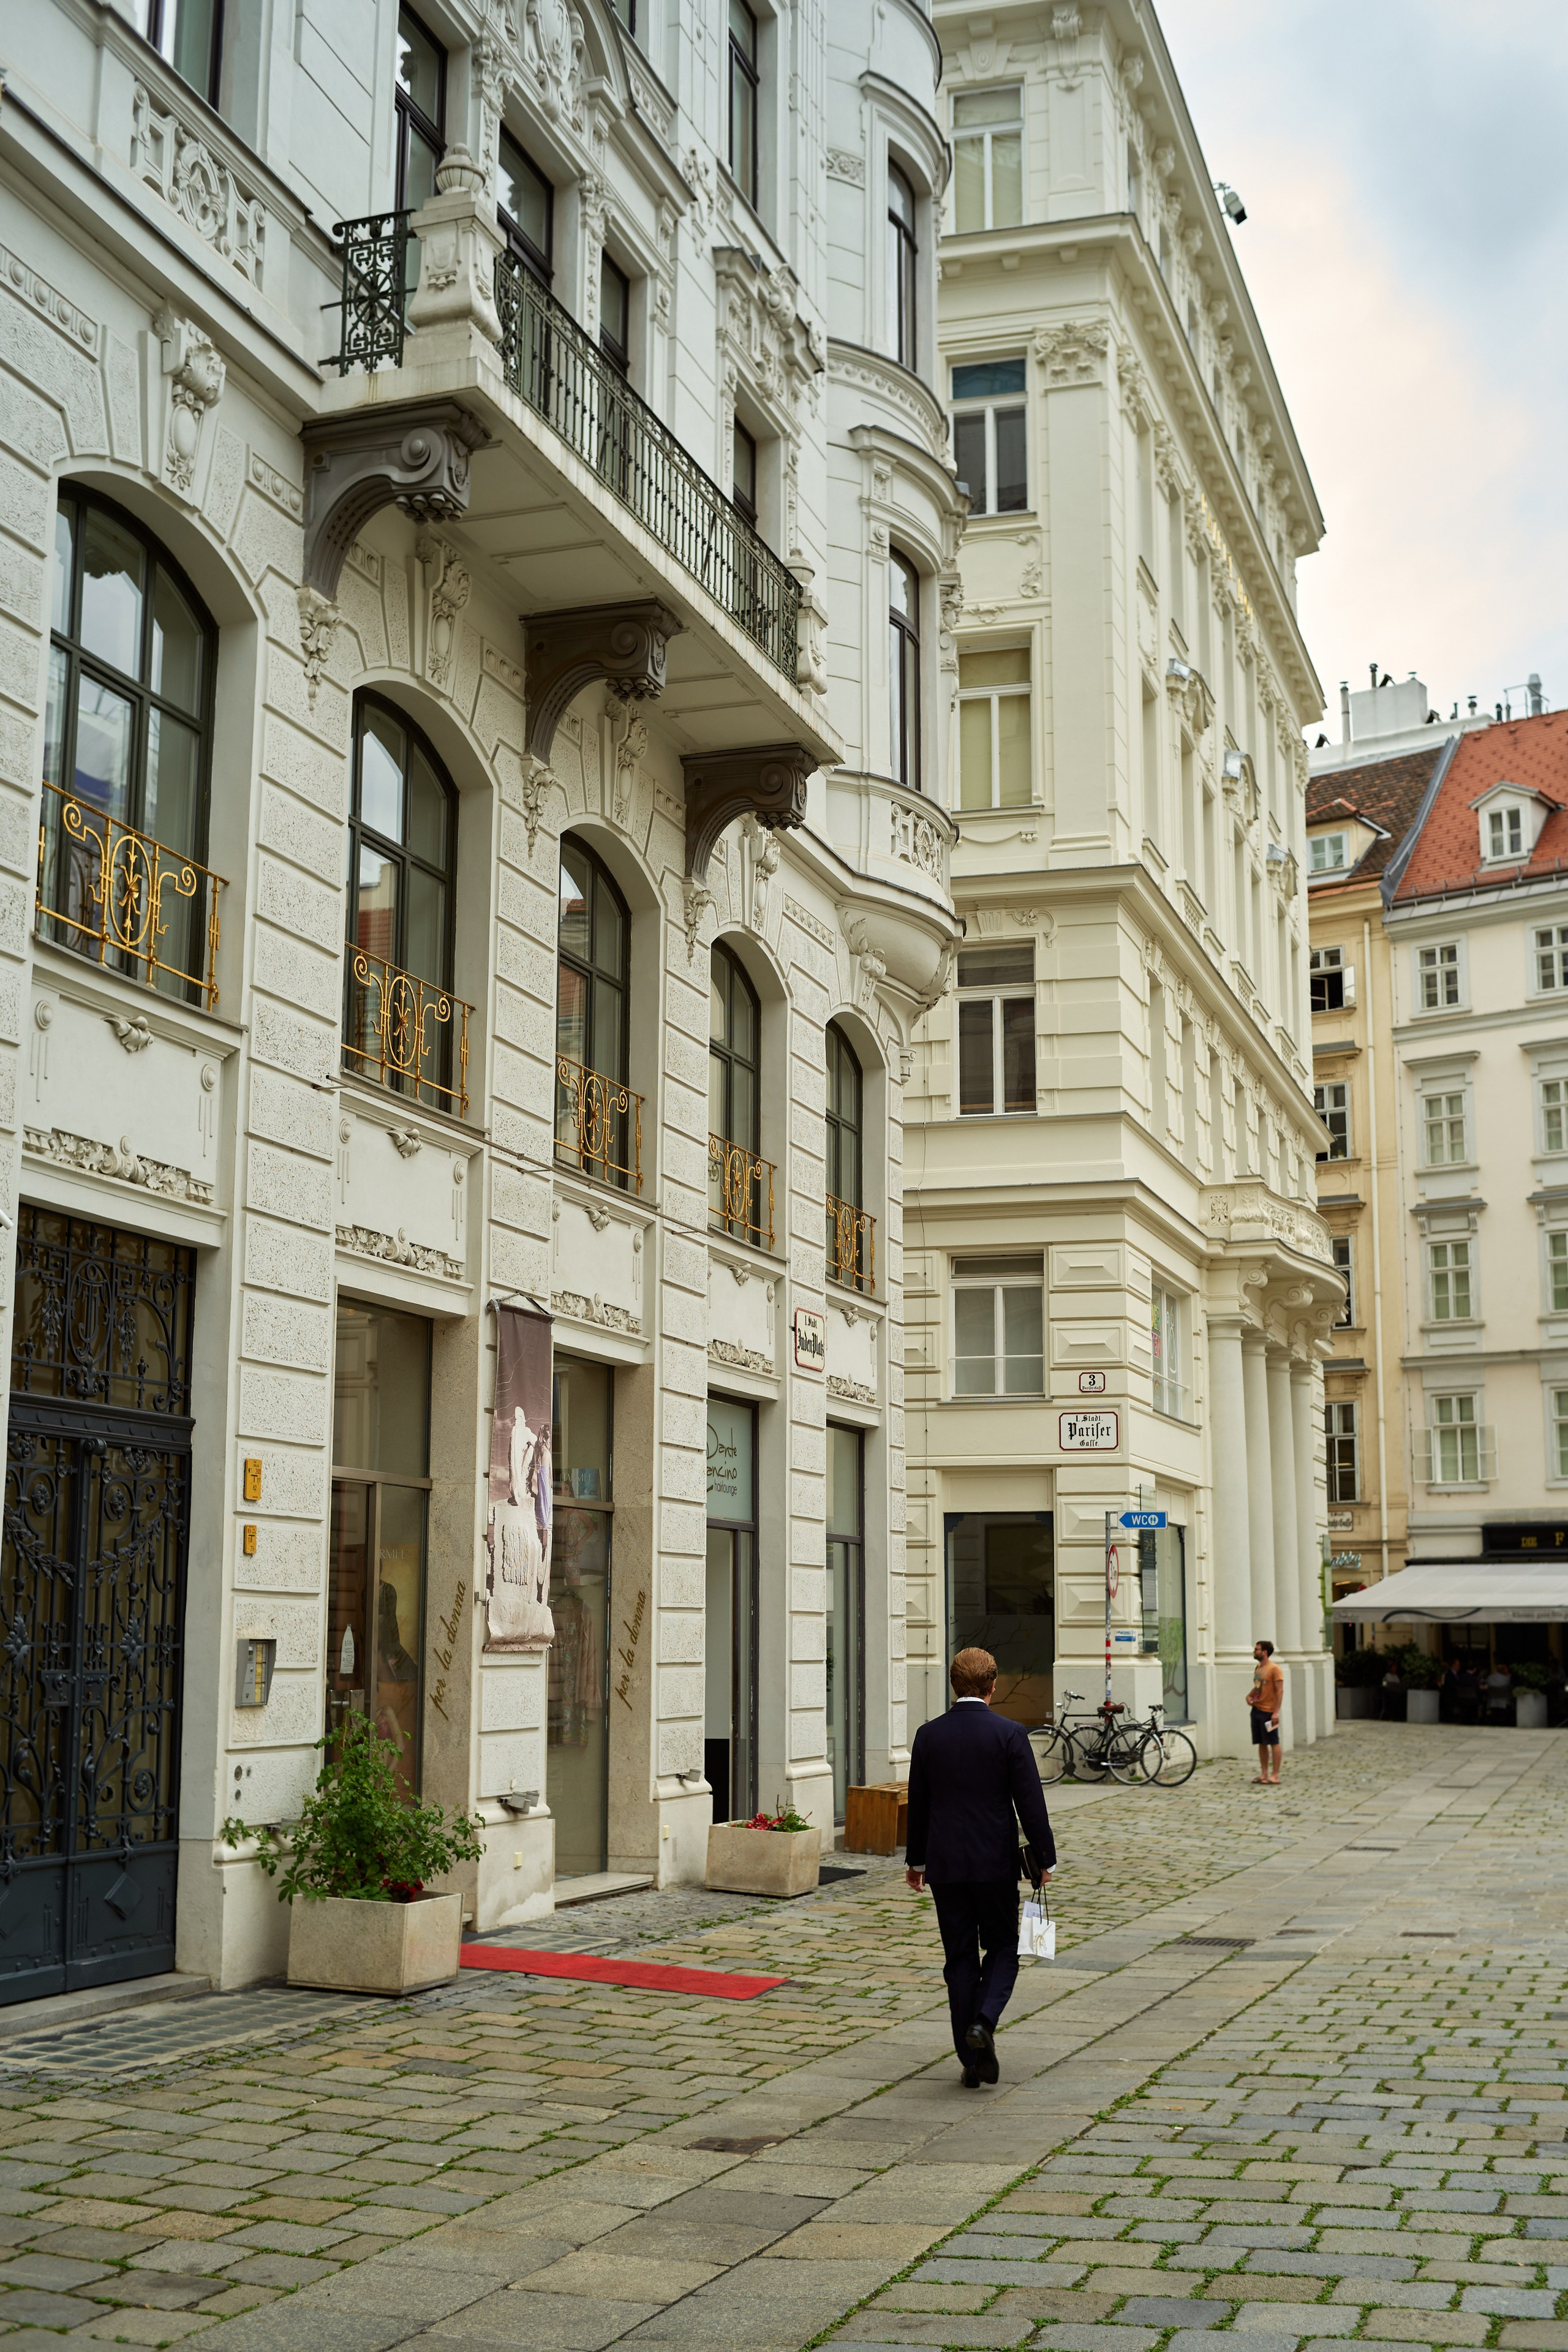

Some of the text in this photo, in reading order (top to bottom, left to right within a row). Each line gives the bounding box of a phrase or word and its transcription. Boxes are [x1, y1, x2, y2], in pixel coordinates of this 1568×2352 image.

[1088, 1374, 1096, 1386] 3
[707, 1461, 737, 1480] ancino
[714, 1479, 737, 1496] hairlounge
[1131, 1515, 1148, 1525] WC
[429, 1580, 466, 1722] per la donna
[615, 1590, 647, 1711] per la donna
